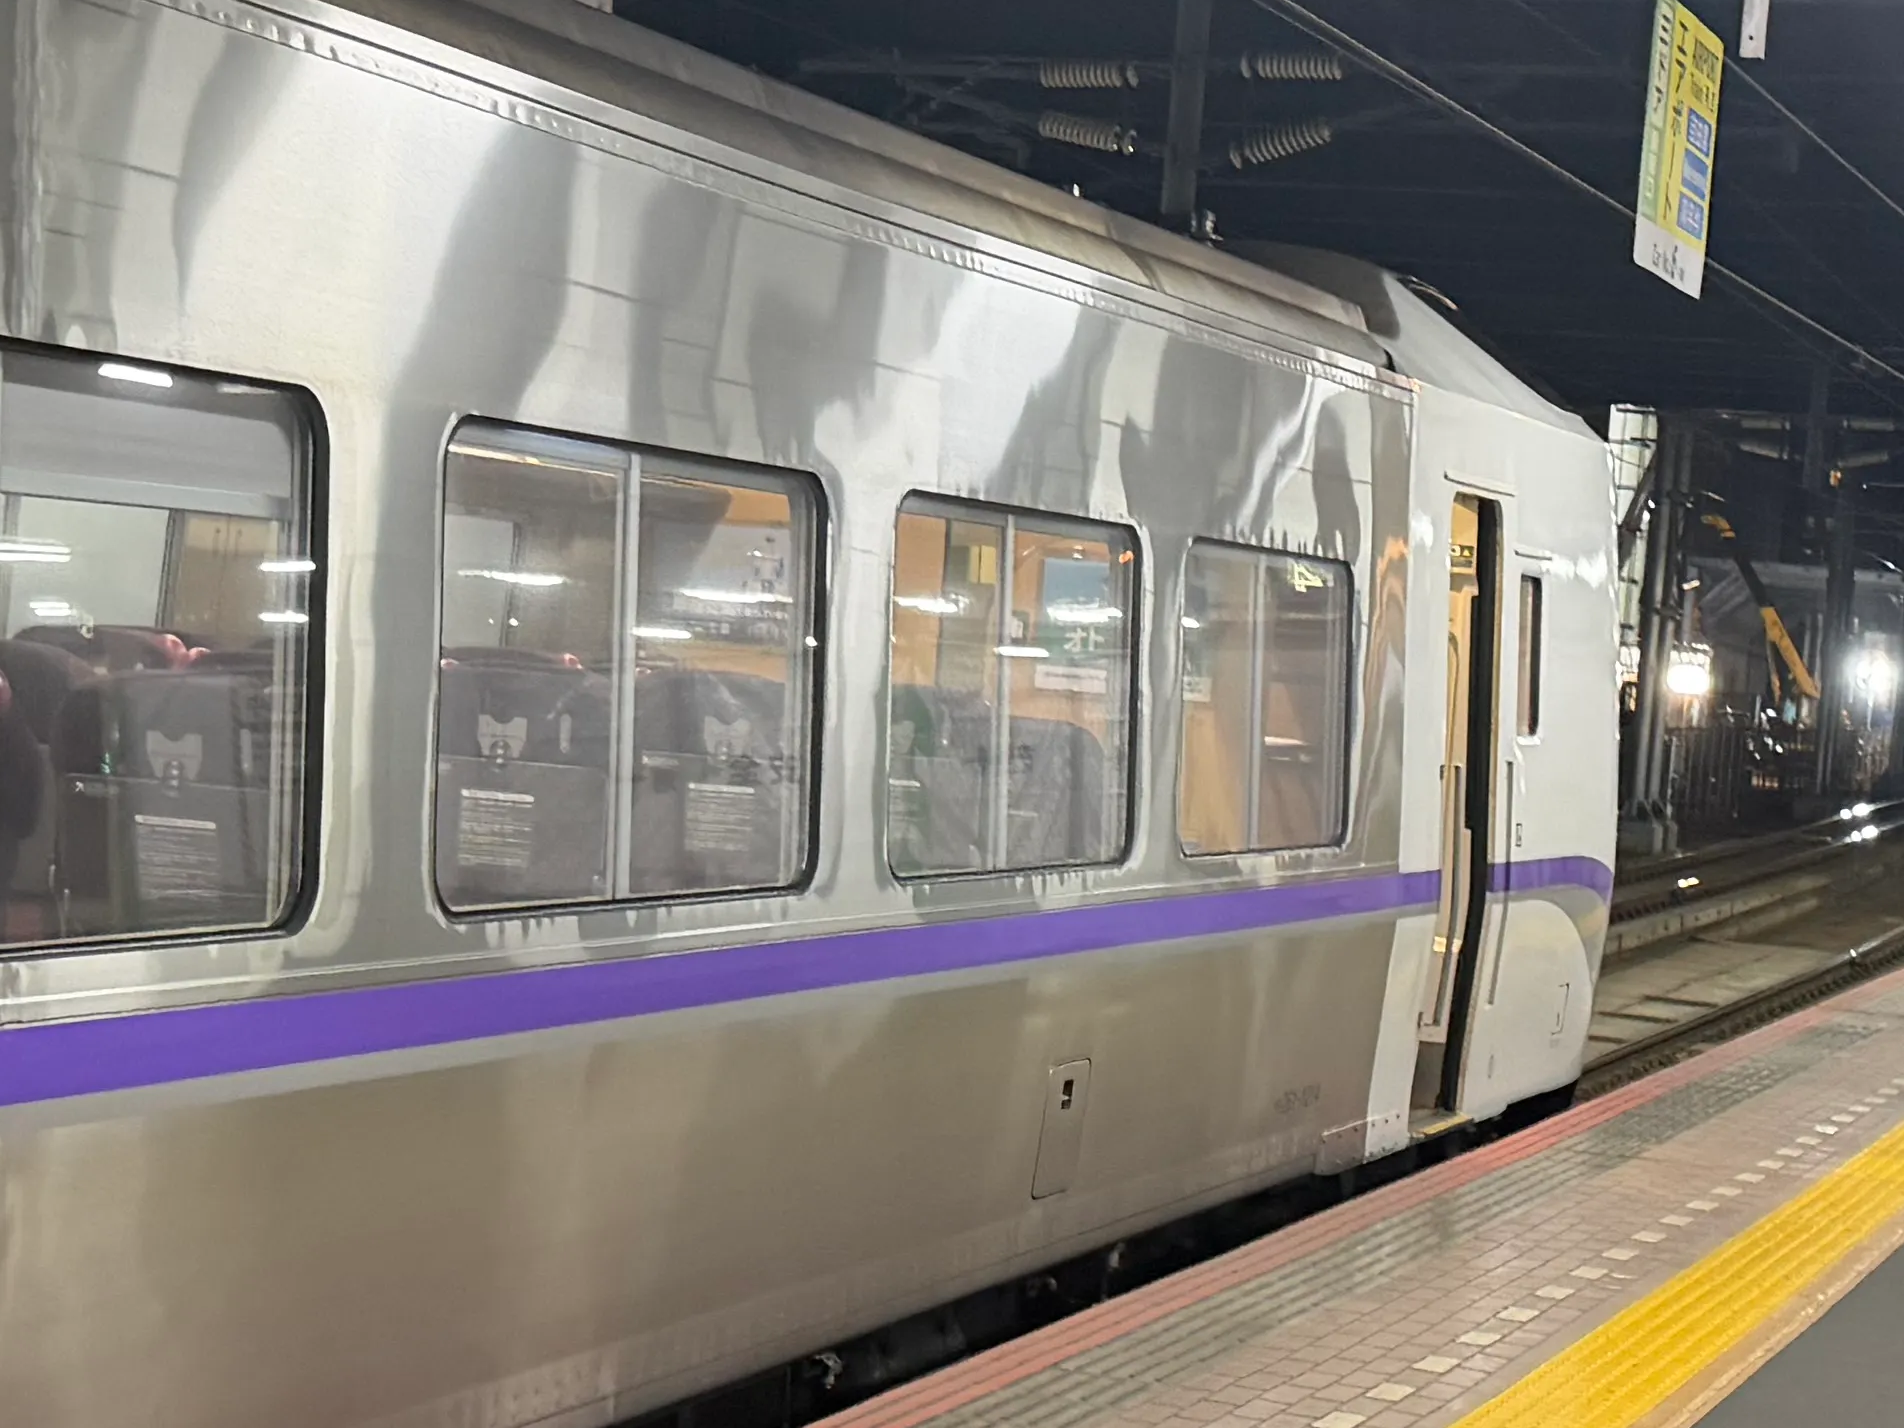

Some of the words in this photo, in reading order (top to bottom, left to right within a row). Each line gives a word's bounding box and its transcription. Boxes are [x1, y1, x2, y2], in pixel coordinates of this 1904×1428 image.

[1662, 19, 1690, 221] エアポート
